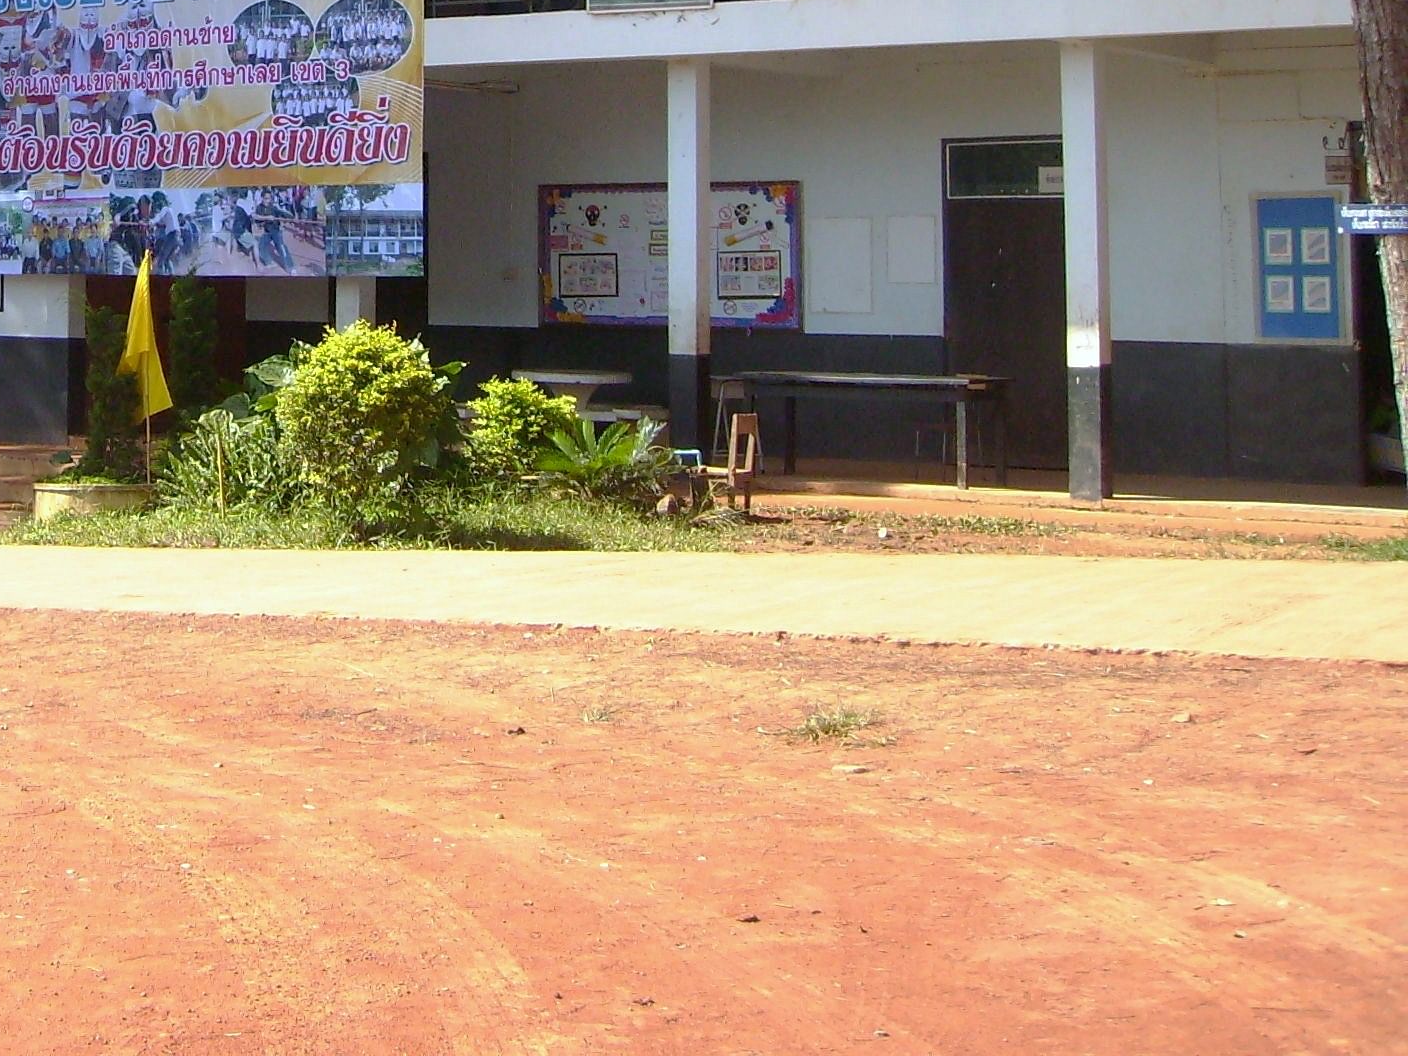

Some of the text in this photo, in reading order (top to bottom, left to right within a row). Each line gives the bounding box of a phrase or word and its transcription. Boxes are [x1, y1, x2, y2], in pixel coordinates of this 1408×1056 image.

[103, 17, 235, 52] อำเภอด่านซ้าย
[2, 54, 350, 96] สำนักงานเขตพื้นที่การศึกษาเลย เขต 3
